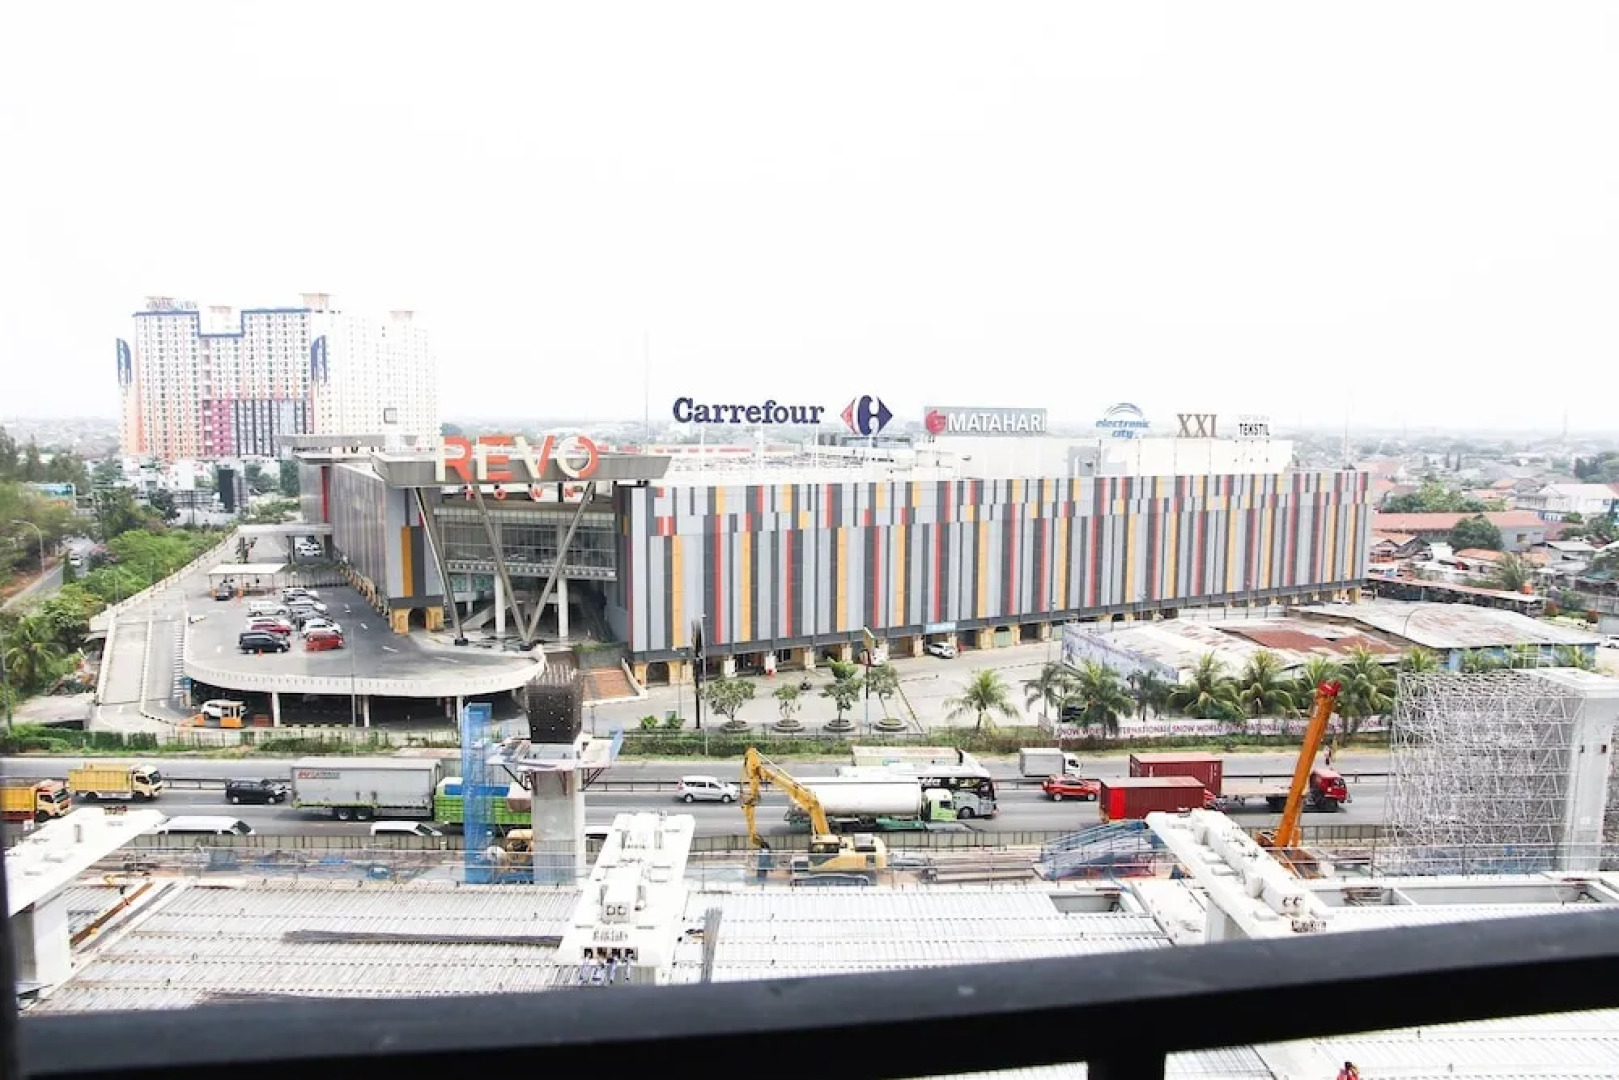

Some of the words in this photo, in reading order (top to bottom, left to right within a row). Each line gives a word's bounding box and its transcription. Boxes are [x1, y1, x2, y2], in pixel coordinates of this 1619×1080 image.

[673, 397, 825, 425] Carrefour
[948, 411, 1046, 432] MATAHARI
[1096, 418, 1150, 428] electronic
[1177, 413, 1218, 438] XXI
[1239, 423, 1270, 436] TEKSTIL
[1112, 429, 1134, 439] city
[434, 434, 599, 482] REVO
[465, 487, 575, 500] TOWN
